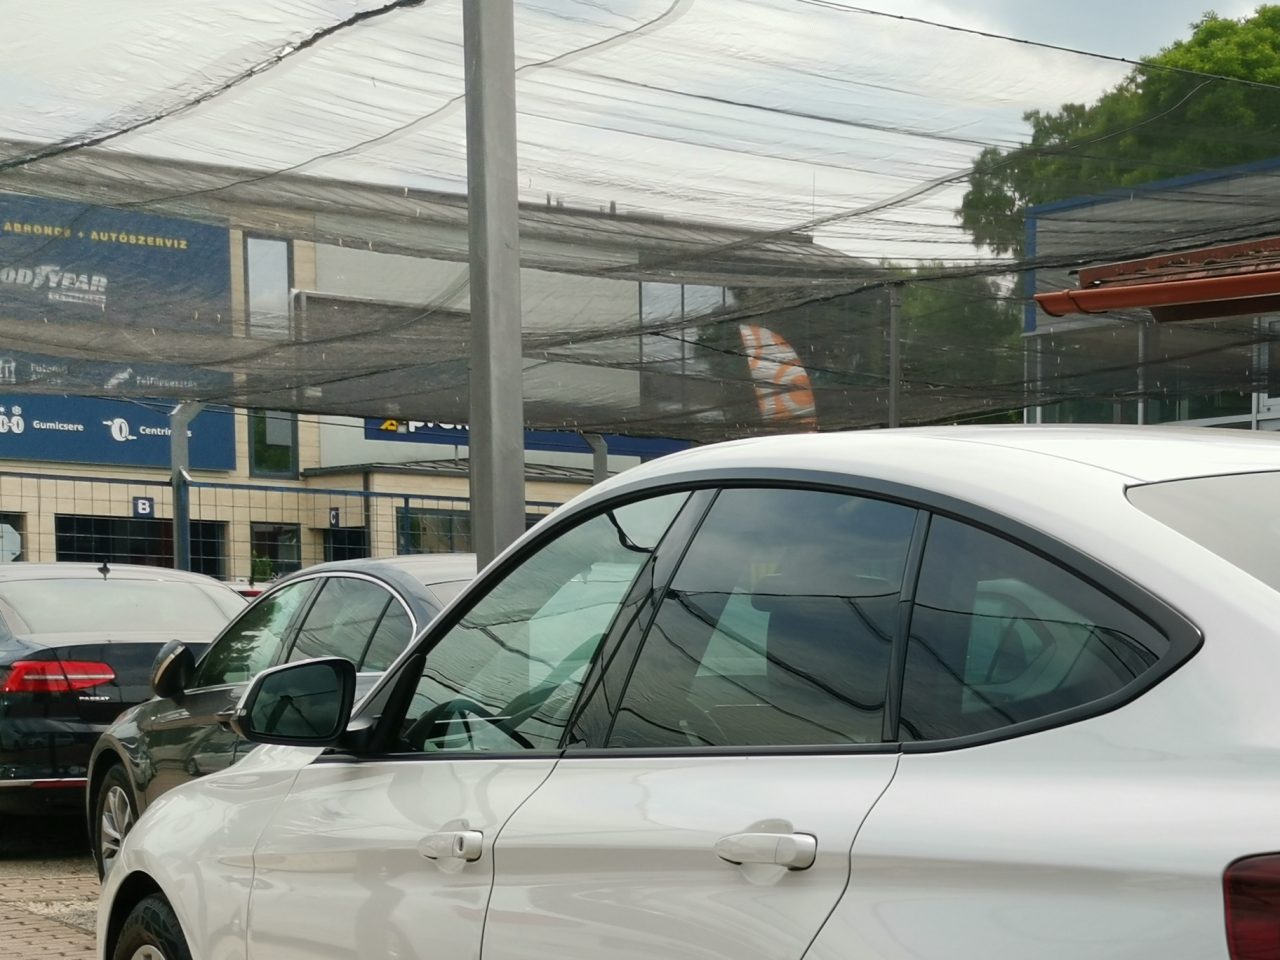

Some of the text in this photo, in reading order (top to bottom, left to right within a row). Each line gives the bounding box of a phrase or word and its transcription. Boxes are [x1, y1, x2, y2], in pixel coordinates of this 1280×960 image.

[91, 230, 188, 249] AUTÓSZERVIZ
[32, 420, 84, 431] Gumicsere
[137, 500, 151, 514] B
[330, 509, 338, 526] C
